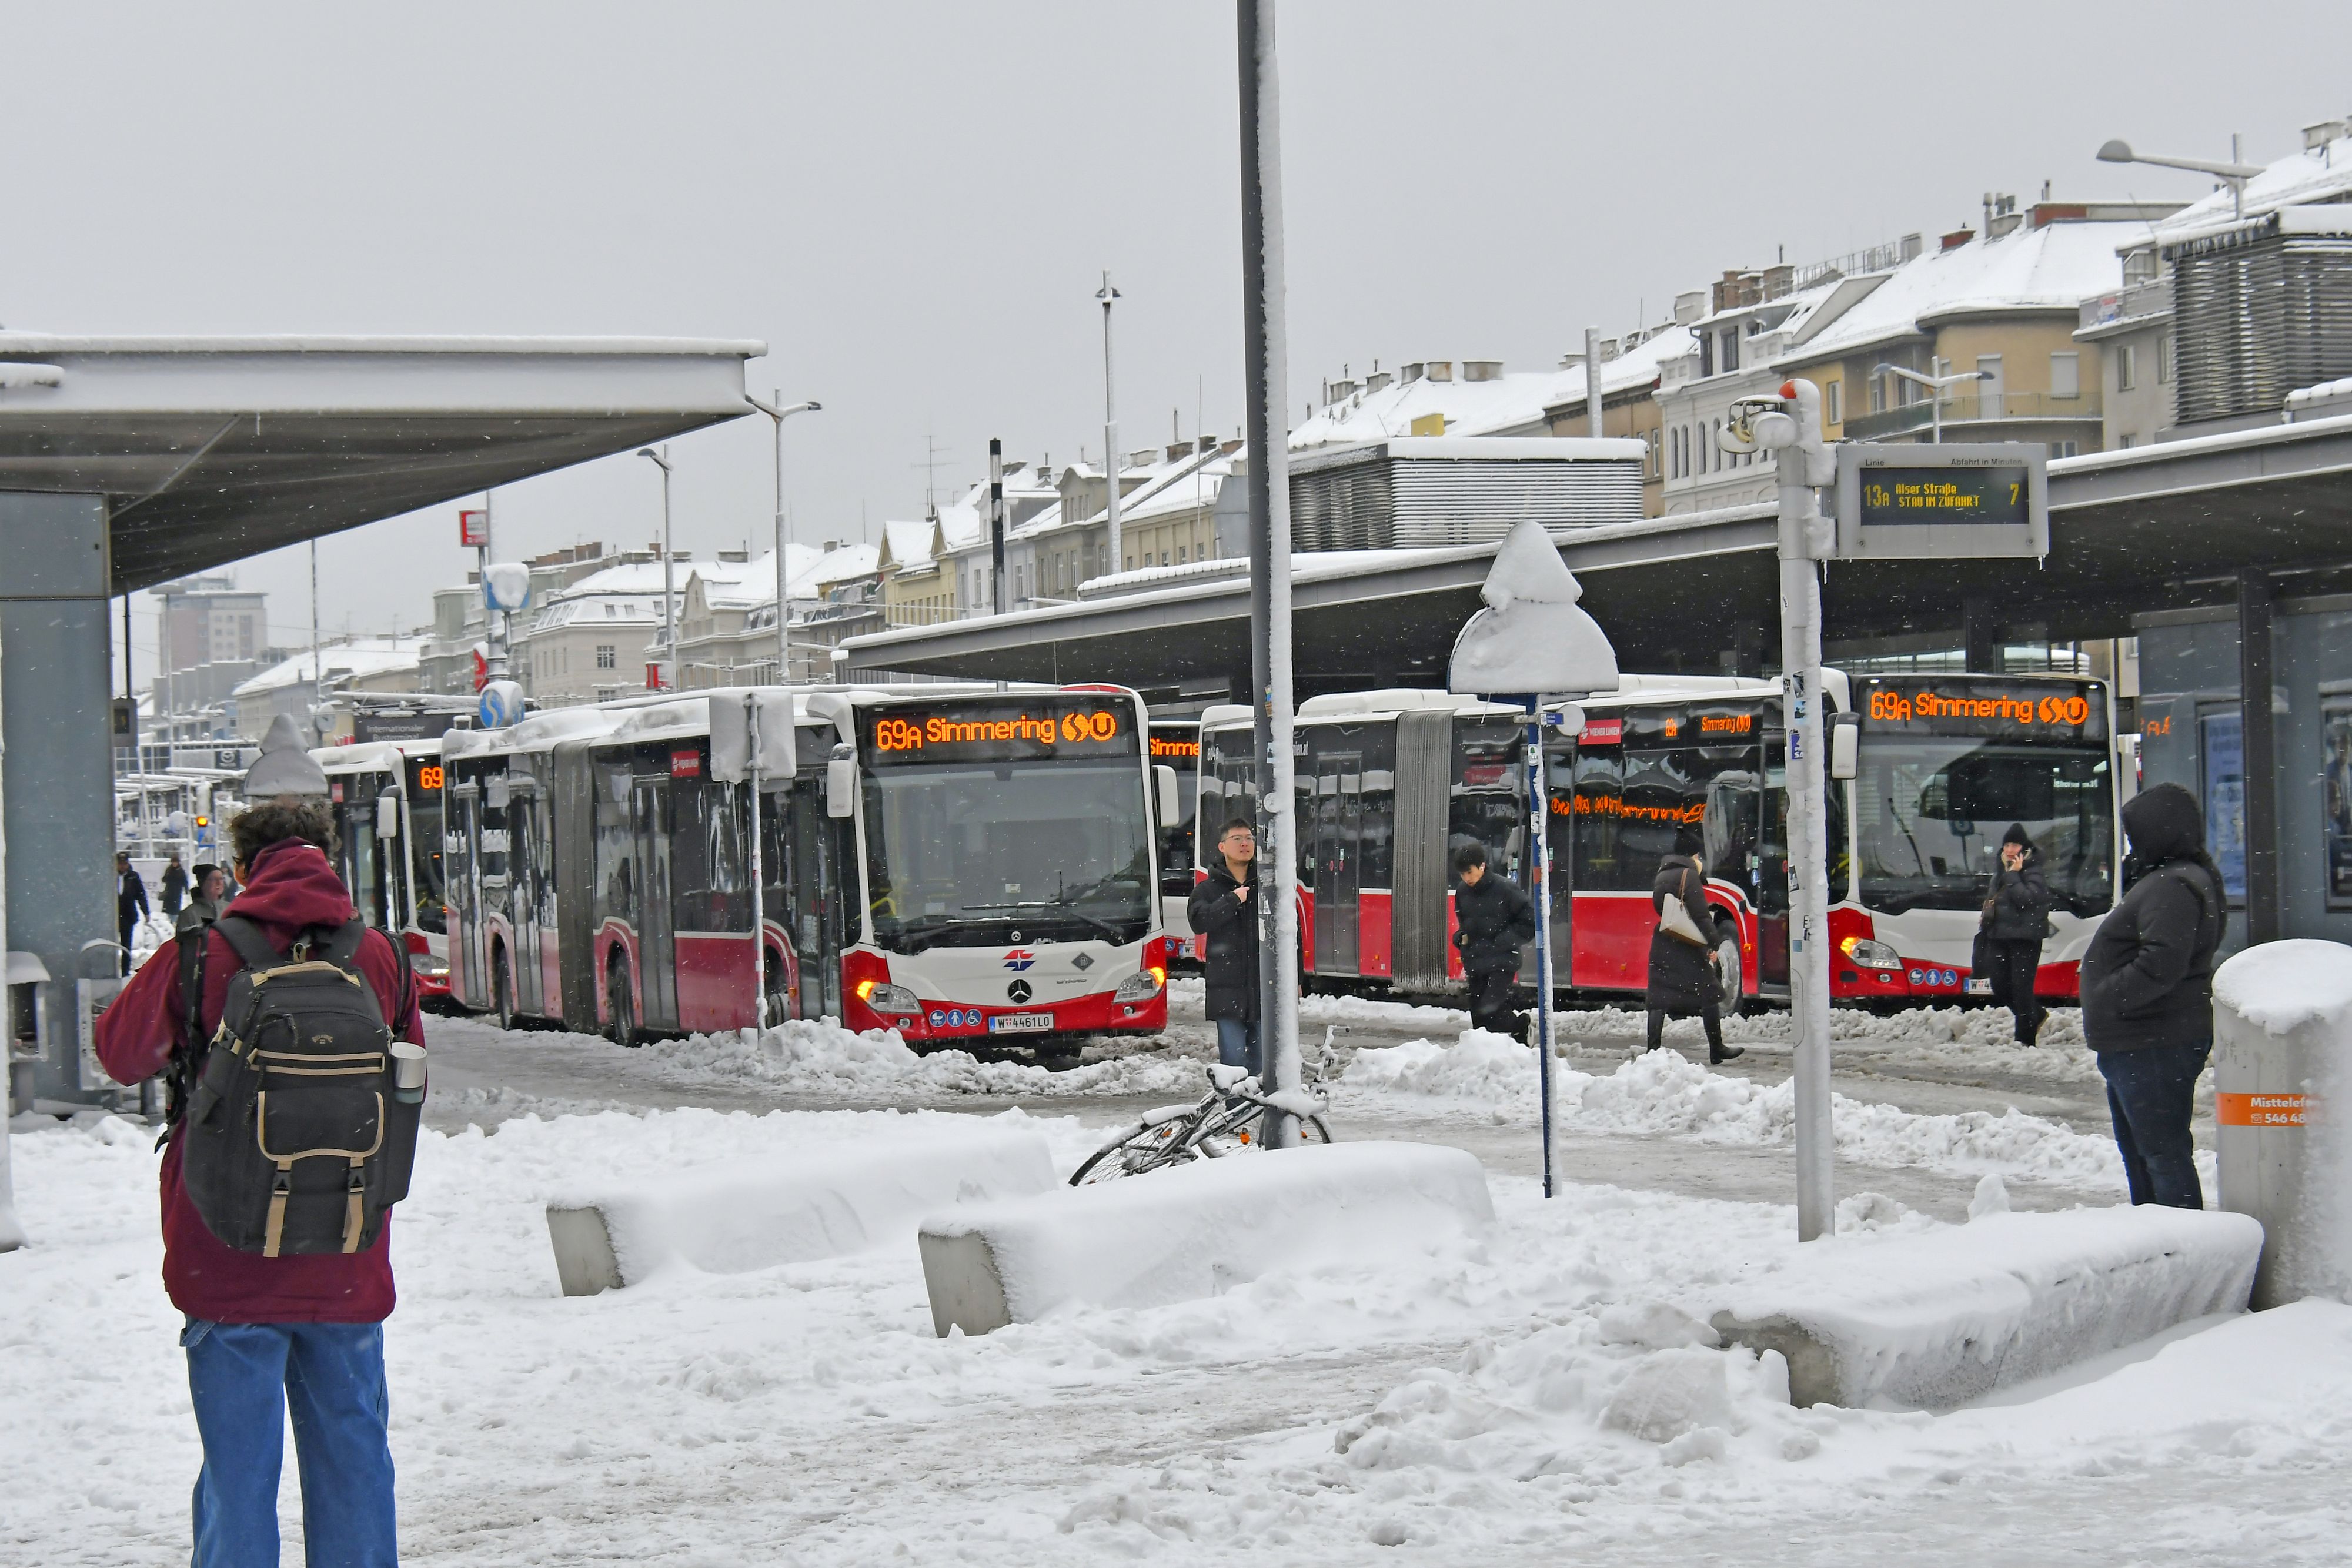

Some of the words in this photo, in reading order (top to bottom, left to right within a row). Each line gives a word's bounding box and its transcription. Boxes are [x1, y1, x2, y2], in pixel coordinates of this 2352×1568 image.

[1864, 484, 1890, 507] 13A
[1895, 483, 1920, 494] Alser
[1923, 483, 1957, 496] Straße
[2010, 483, 2020, 506] 7
[1899, 496, 1923, 507] STAU
[1939, 496, 1980, 507] ZUFAHRT
[1870, 691, 1911, 720] 69A
[1916, 693, 2033, 724] Simmering
[367, 724, 425, 733] Internationaler
[1702, 715, 1735, 734] Simmering
[373, 734, 419, 742] Busterminal
[877, 719, 923, 751] 69A
[926, 714, 1057, 744] Simmering
[2264, 1113, 2288, 1124] 546
